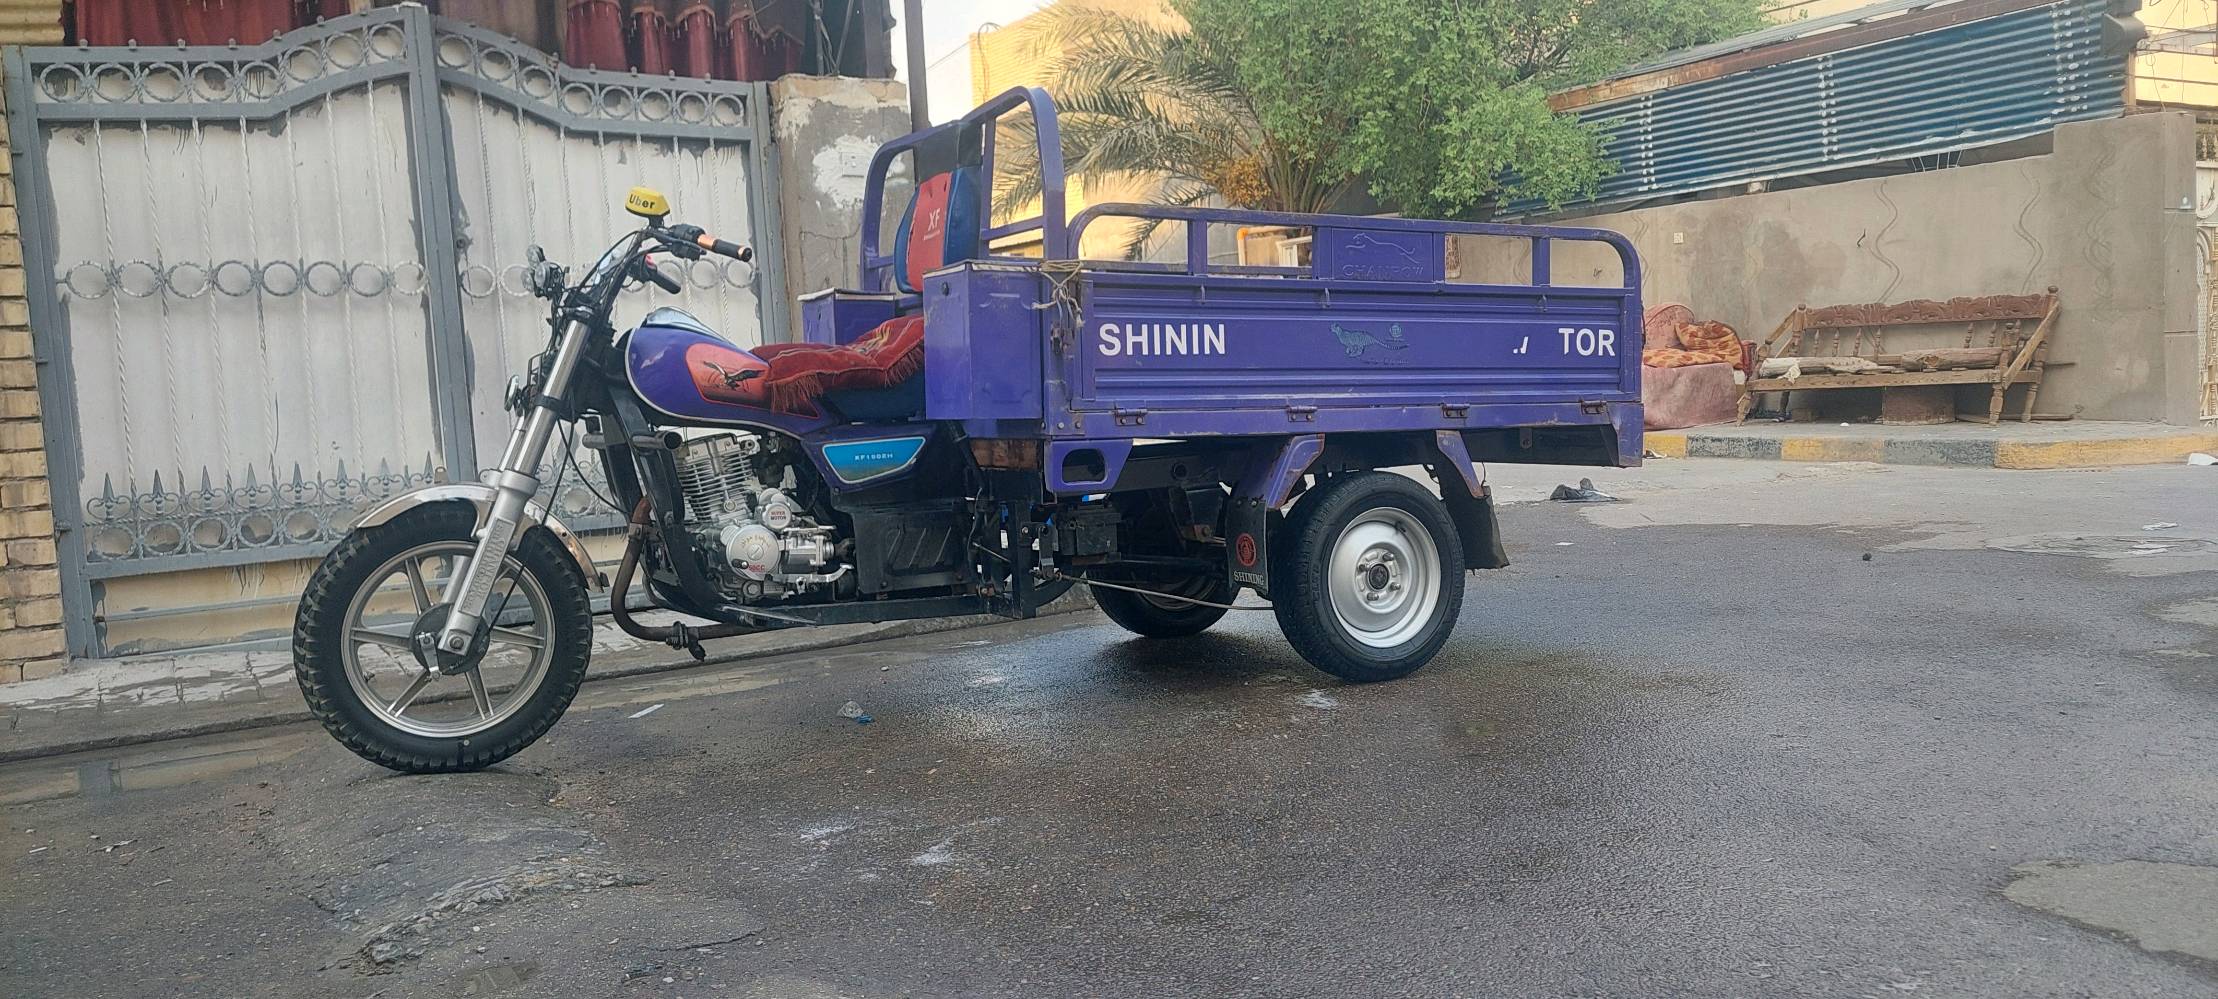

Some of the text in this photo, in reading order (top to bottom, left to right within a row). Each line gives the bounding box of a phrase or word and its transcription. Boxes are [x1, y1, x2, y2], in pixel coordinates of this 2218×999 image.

[629, 194, 656, 209] Uber
[928, 208, 940, 231] XF
[1099, 323, 1226, 356] SHININ
[1558, 328, 1616, 356] TOR
[1233, 571, 1264, 585] SHINING
